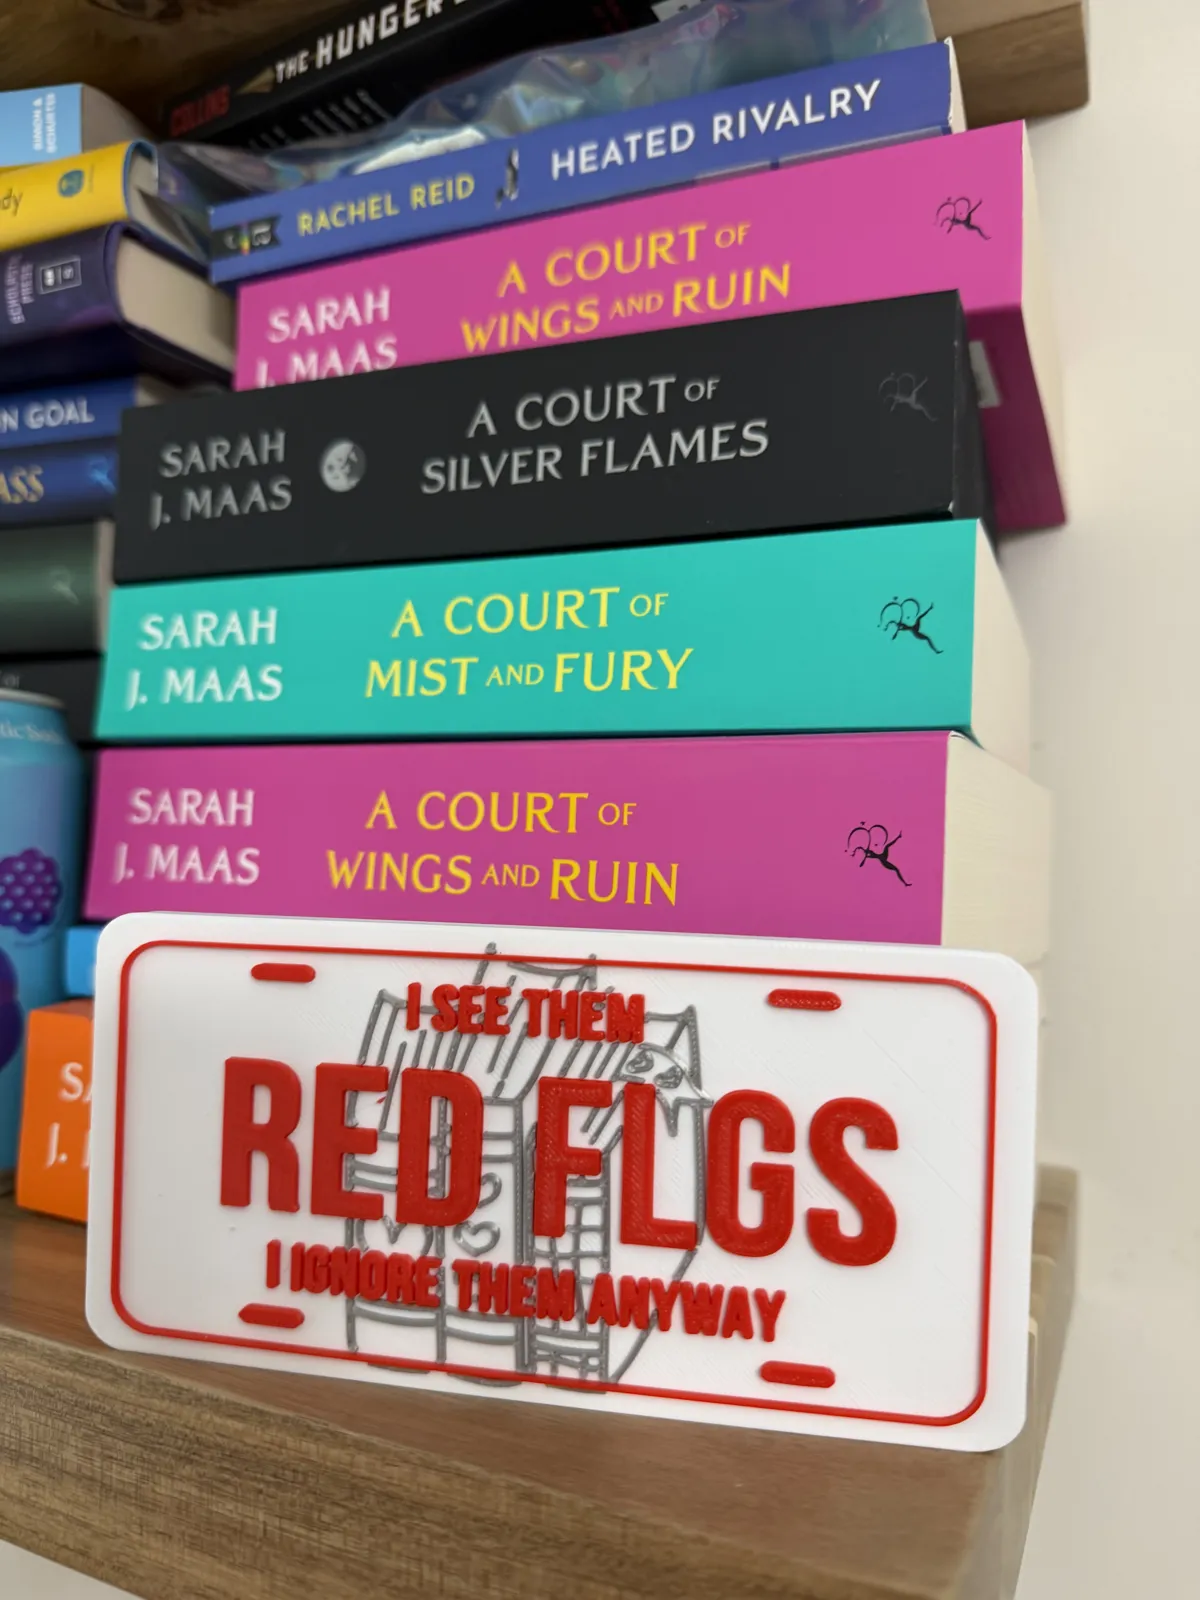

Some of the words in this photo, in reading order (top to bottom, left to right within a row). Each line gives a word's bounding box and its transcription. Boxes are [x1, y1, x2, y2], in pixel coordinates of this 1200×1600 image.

[276, 51, 309, 83] THE
[315, 0, 442, 69] HUNGER
[552, 121, 696, 180] HEATED
[712, 79, 881, 145] RIVALRY
[297, 191, 400, 236] RACHEL
[410, 173, 476, 210] REID
[497, 259, 527, 298] A
[545, 221, 707, 288] COURT
[715, 222, 751, 249] OF
[267, 286, 391, 343] SARAH
[460, 297, 601, 353] WINGS
[609, 291, 664, 321] AND
[672, 261, 792, 318] RUIN
[288, 334, 398, 384] MAAS
[24, 395, 95, 430] GOAL
[467, 400, 498, 438] A
[514, 374, 677, 431] COURT
[683, 376, 721, 402] OF
[159, 428, 286, 478] SARAH
[420, 443, 563, 494] SILVER
[579, 417, 769, 477] FLAMES
[150, 492, 172, 531] J.
[182, 475, 293, 521] MAAS
[138, 606, 279, 651] SARAH
[391, 598, 424, 638] A
[444, 586, 621, 635] COURT
[629, 592, 669, 618] OF
[125, 668, 148, 712] J.
[160, 663, 283, 703] MAAS
[365, 655, 480, 698] MIST
[485, 663, 545, 687] AND
[553, 647, 694, 692] FURY
[127, 787, 255, 826] SARAH
[365, 790, 399, 830] A
[416, 791, 590, 834] COURT
[597, 802, 638, 826] OF
[111, 841, 135, 885] J.
[145, 843, 261, 887] MAAS
[326, 849, 473, 896] WINGS
[481, 863, 541, 888] AND
[549, 858, 680, 907] RUIN
[407, 982, 422, 1030] I
[431, 984, 513, 1034] SEE
[521, 988, 646, 1043] THEM
[60, 1061, 93, 1102] S
[45, 1122, 68, 1167] J.
[219, 1056, 485, 1227] RED
[532, 1076, 900, 1267] FLGS
[266, 1239, 281, 1289] I
[290, 1241, 443, 1307] IGNORE
[451, 1259, 576, 1322] THEM
[586, 1272, 787, 1343] ANYWAY
